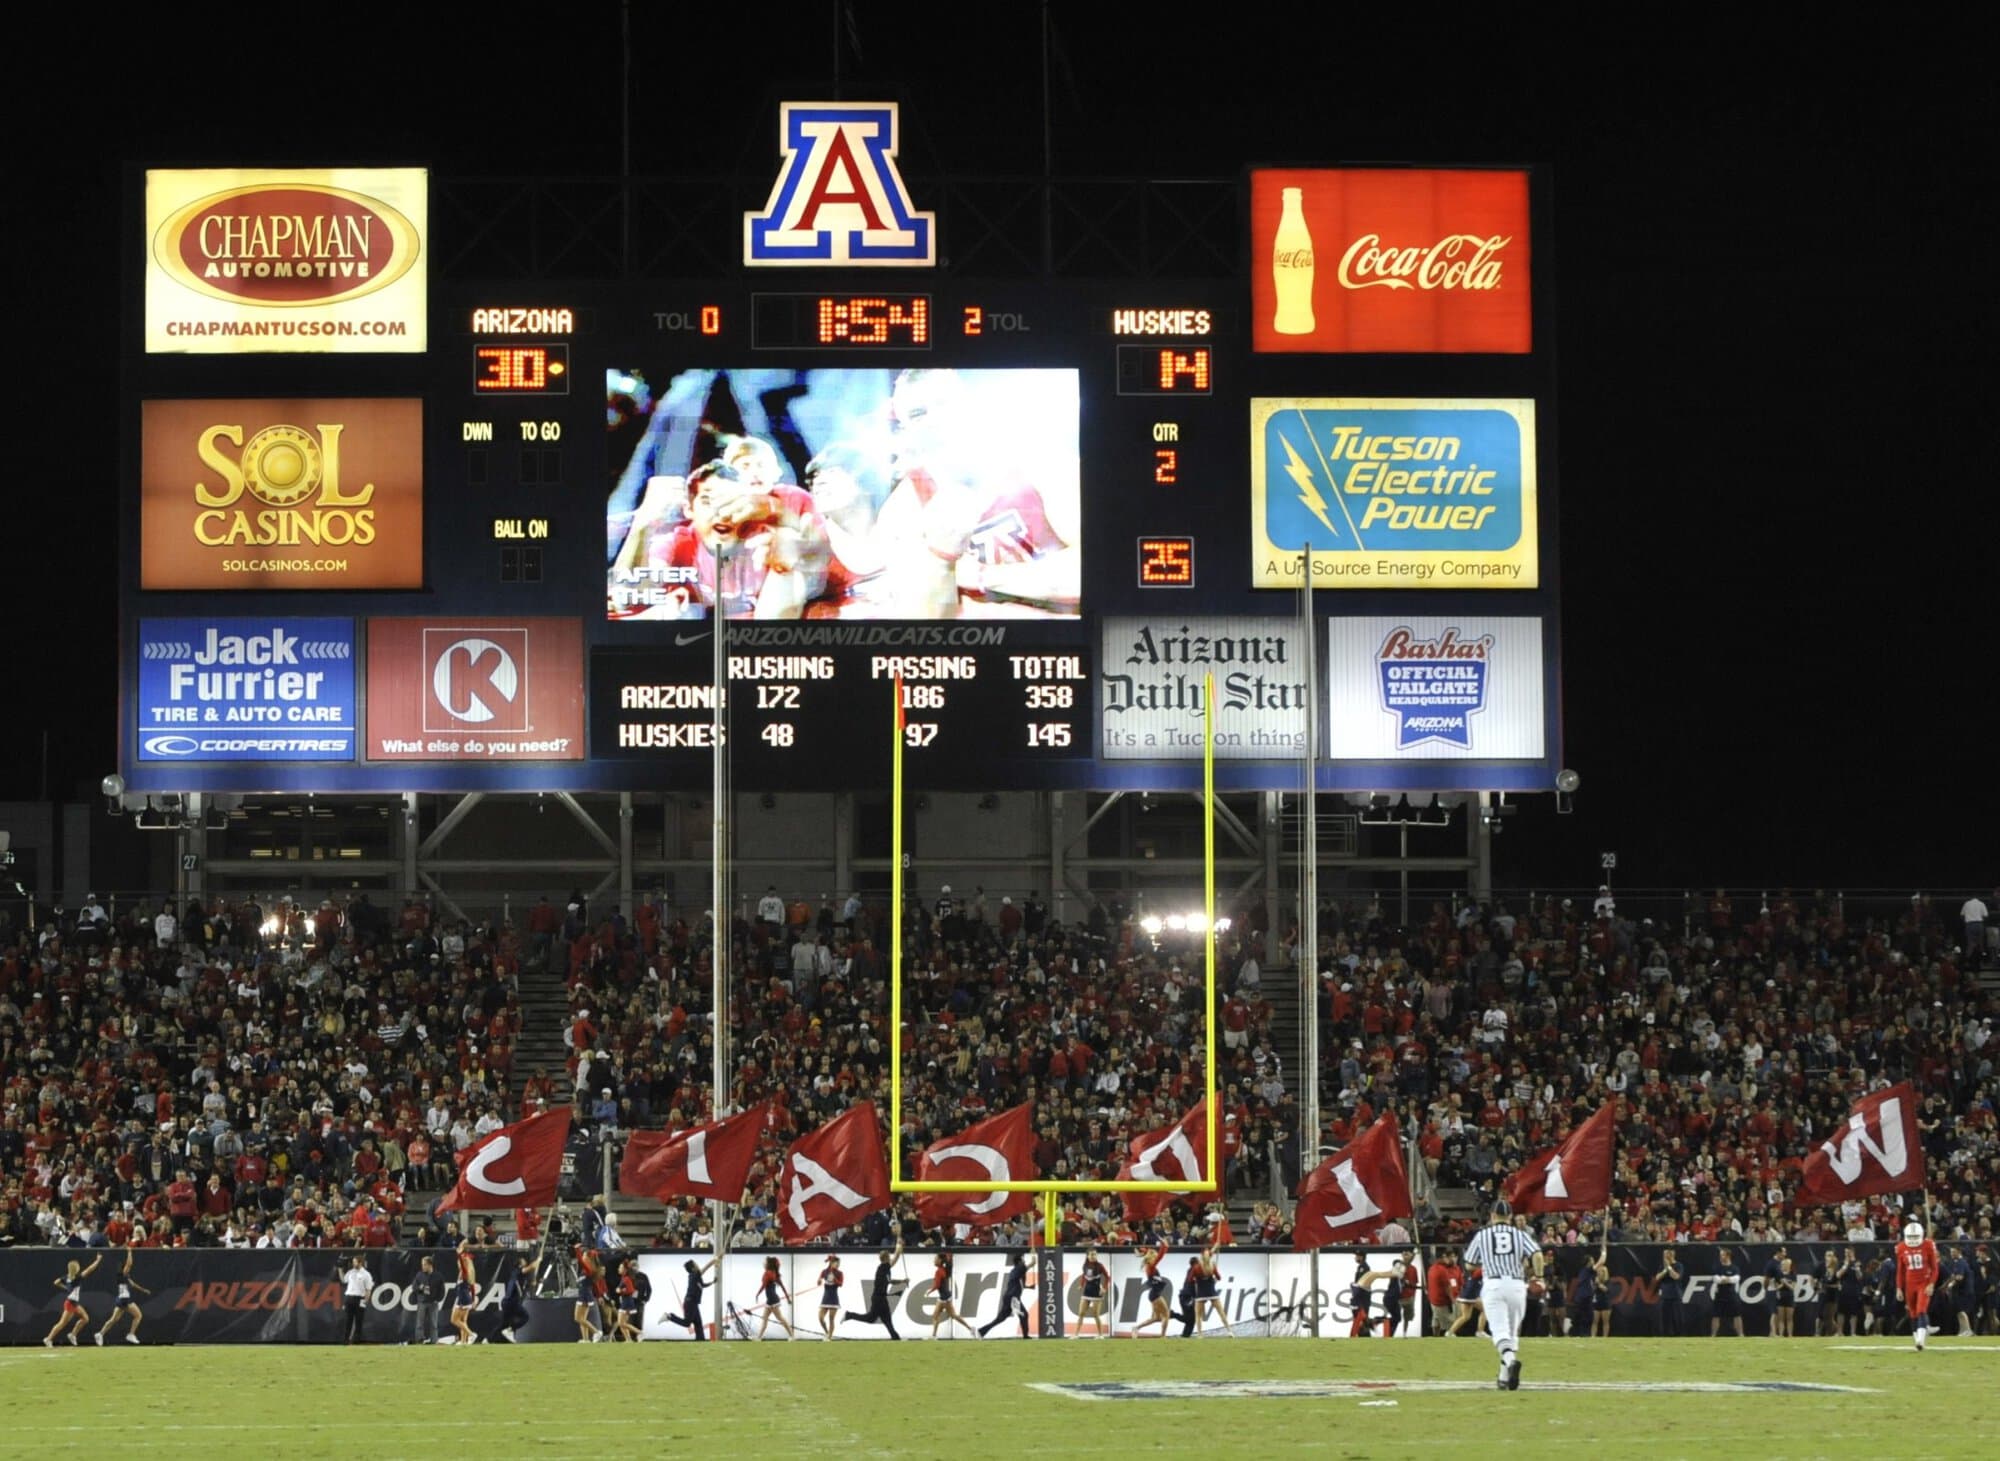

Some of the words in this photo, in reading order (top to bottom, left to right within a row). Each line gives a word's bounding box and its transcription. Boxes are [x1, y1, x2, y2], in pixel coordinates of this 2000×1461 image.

[199, 215, 372, 260] CHAPMAN
[204, 261, 369, 278] AUTOMOTIVE
[1338, 233, 1513, 290] Coca-Cola
[166, 320, 407, 337] CHAPMANTUCSON.COM
[472, 308, 573, 334] ARIZONA
[654, 312, 696, 331] TOL
[819, 298, 927, 343] 1:54
[963, 306, 982, 335] 2
[988, 312, 1031, 331] TOL
[1113, 309, 1211, 335] HUSKIES
[477, 348, 546, 389] 30
[1160, 350, 1209, 389] 14
[462, 422, 493, 441] DWN
[520, 422, 538, 441] TO
[541, 422, 561, 441] GO
[1153, 423, 1179, 442] QTR
[1331, 426, 1461, 461] Tucson
[194, 423, 375, 508] SOL
[1155, 450, 1176, 482] 2
[1344, 462, 1497, 495] Electric
[1360, 497, 1497, 530] Power
[193, 510, 376, 546] CASINOS
[494, 520, 525, 538] BALL
[528, 520, 548, 538] ON
[222, 558, 348, 572] SOLCASINOS.COM
[1143, 543, 1190, 581] 25
[1265, 561, 1278, 575] A
[1377, 561, 1436, 579] Energy
[1441, 561, 1522, 579] Company
[616, 567, 698, 583] AFTER
[618, 588, 667, 605] THE
[194, 628, 299, 665] Jack
[723, 626, 1006, 647] ARIZONAWILDCATS.COM
[1126, 624, 1288, 665] Arizona
[1381, 630, 1491, 659] Bashas'
[728, 656, 834, 680] RUSHING
[871, 656, 976, 680] PASSING
[1009, 656, 1087, 680] TOTAL
[1387, 666, 1479, 680] OFFICIAL
[169, 664, 324, 701] Furrier
[1101, 671, 1206, 718] Daily
[1223, 671, 1307, 712] Star
[1387, 681, 1479, 695] TAILGATE
[756, 686, 801, 709] 172
[901, 686, 945, 709] 186
[1025, 686, 1073, 709] 358
[1387, 696, 1479, 706] HEADQUARTERS
[151, 706, 198, 723] TIRE
[204, 706, 219, 723] &
[226, 706, 282, 723] AUTO
[287, 706, 342, 723] CARE
[1404, 716, 1464, 728] ARIZONA
[381, 739, 423, 753] What
[427, 739, 460, 753] else
[463, 739, 485, 753] do
[487, 742, 516, 755] you
[519, 738, 569, 753] need?
[760, 724, 795, 747] 48
[906, 724, 938, 747] 97
[1027, 724, 1071, 747] 145
[1105, 728, 1137, 746] It's
[1144, 732, 1157, 746] a
[1164, 727, 1241, 746] Tucon
[1249, 728, 1306, 751] thing
[183, 855, 197, 870] 27
[1602, 852, 1616, 868] 29
[173, 1280, 342, 1312] ARIZONA
[1044, 1259, 1057, 1337] ARIZONA
